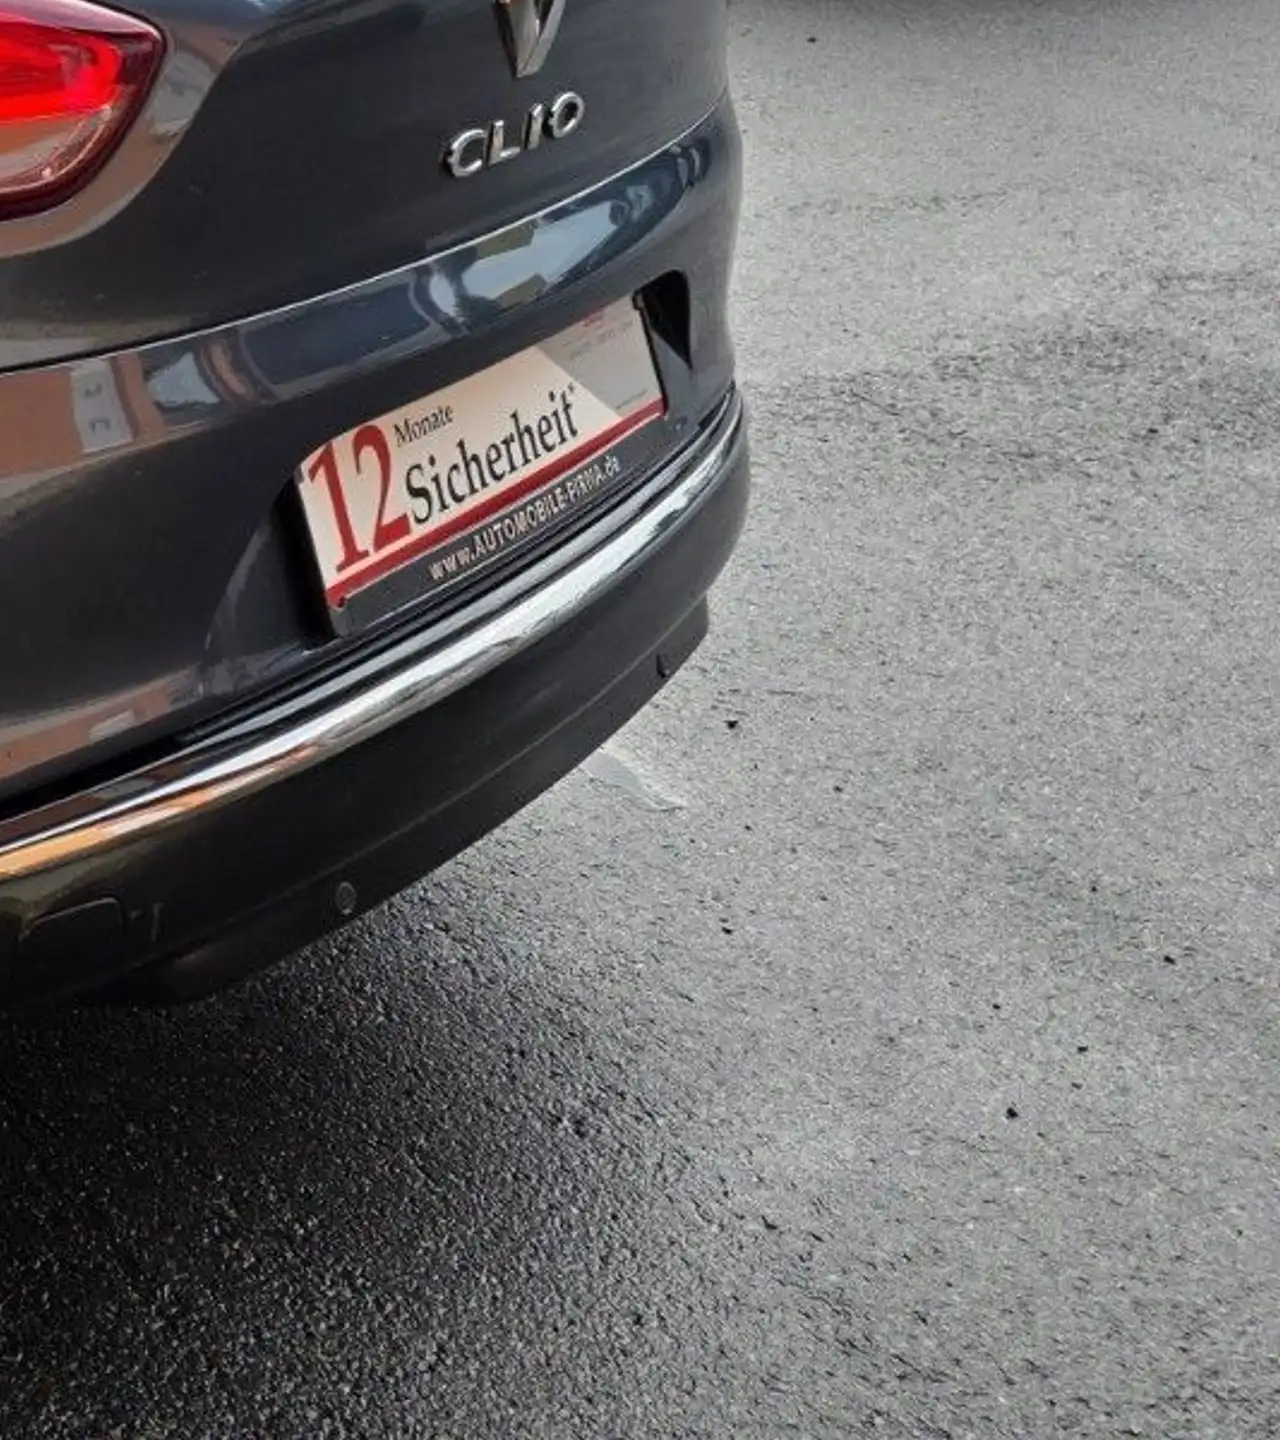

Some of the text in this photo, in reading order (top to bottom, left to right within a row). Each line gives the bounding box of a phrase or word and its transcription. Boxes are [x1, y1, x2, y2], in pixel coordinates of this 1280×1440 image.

[446, 91, 585, 177] CLIO
[393, 405, 455, 448] Monate
[308, 424, 412, 574] 12
